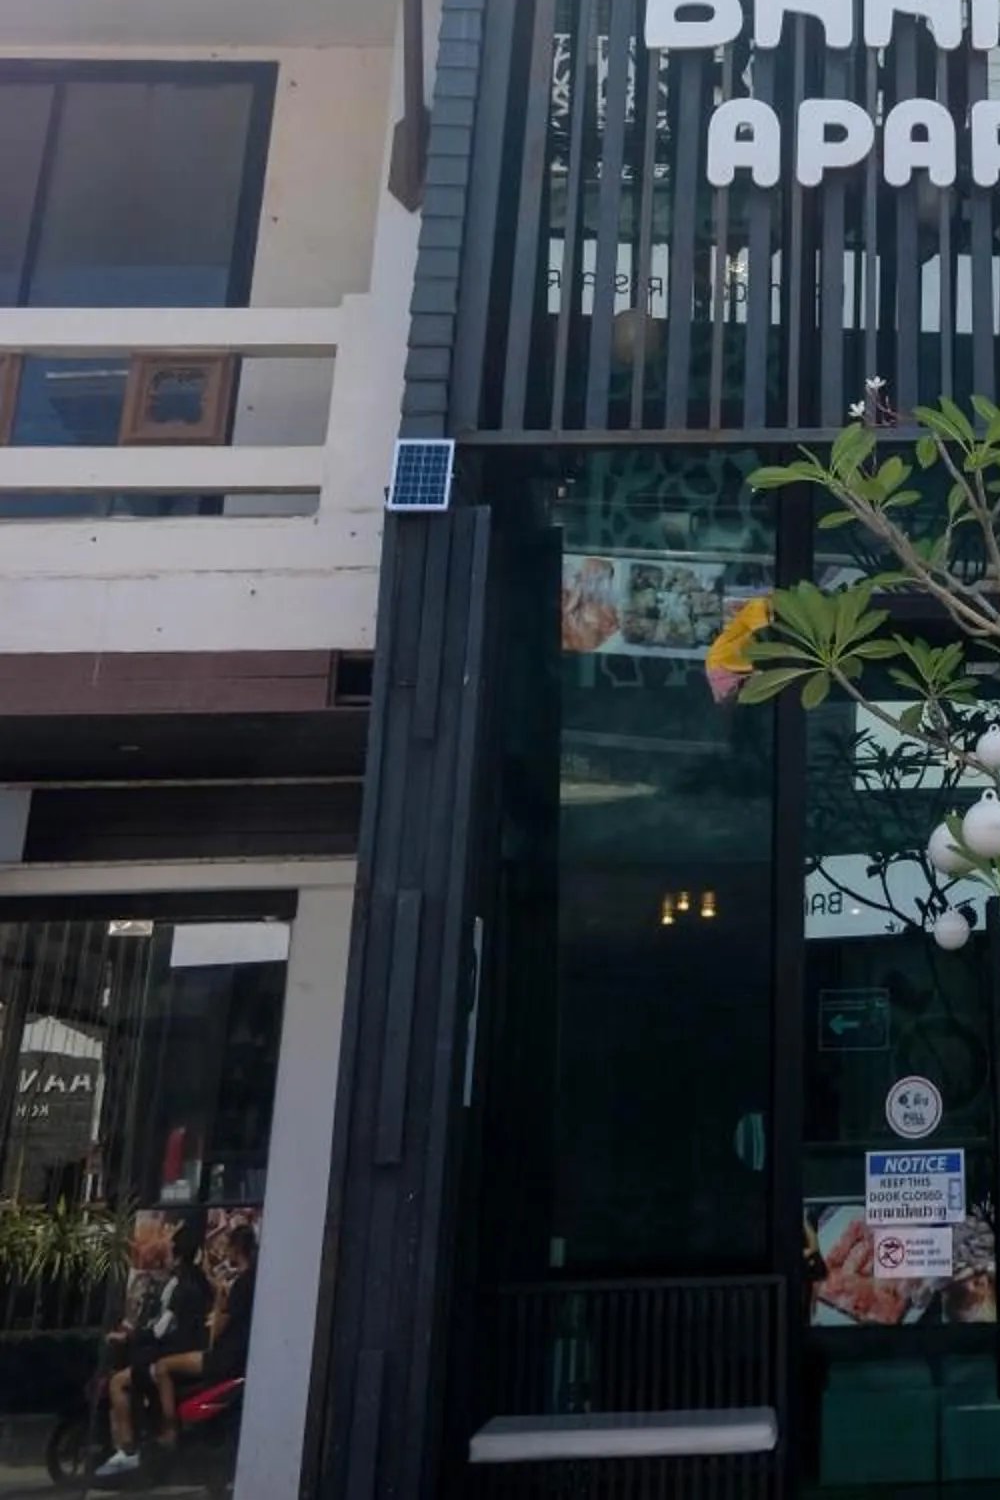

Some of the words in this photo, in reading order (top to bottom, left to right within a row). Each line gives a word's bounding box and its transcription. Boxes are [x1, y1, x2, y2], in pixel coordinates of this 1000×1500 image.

[883, 1155, 948, 1174] NOTICE
[880, 1177, 905, 1190] KEEP
[908, 1176, 931, 1189] THIS
